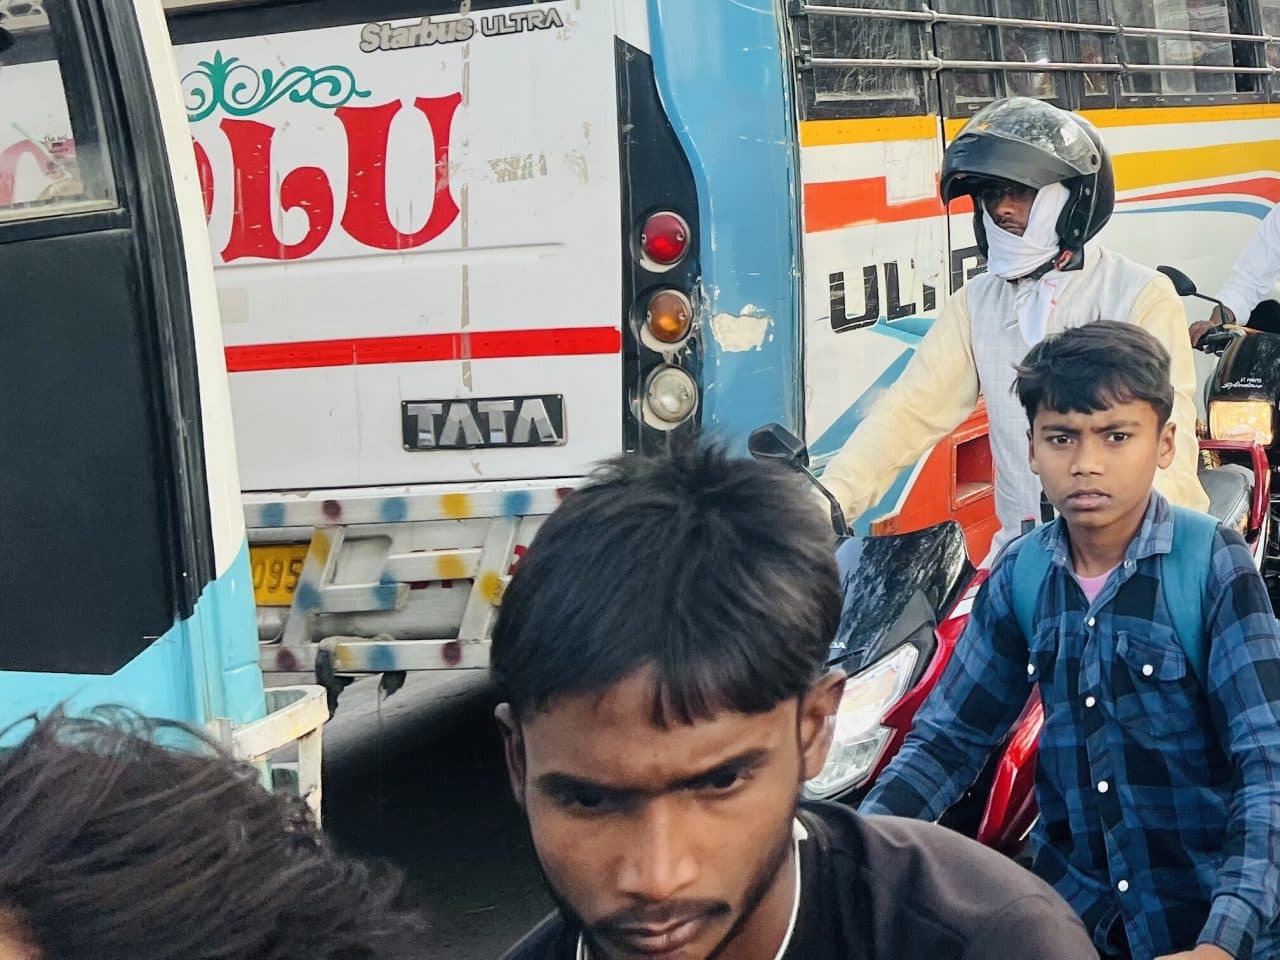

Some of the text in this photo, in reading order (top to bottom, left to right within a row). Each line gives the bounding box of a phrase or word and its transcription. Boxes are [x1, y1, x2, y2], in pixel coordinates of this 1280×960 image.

[359, 8, 564, 53] Starbus ULTRA
[192, 92, 462, 263] LU
[407, 398, 558, 448] TATA
